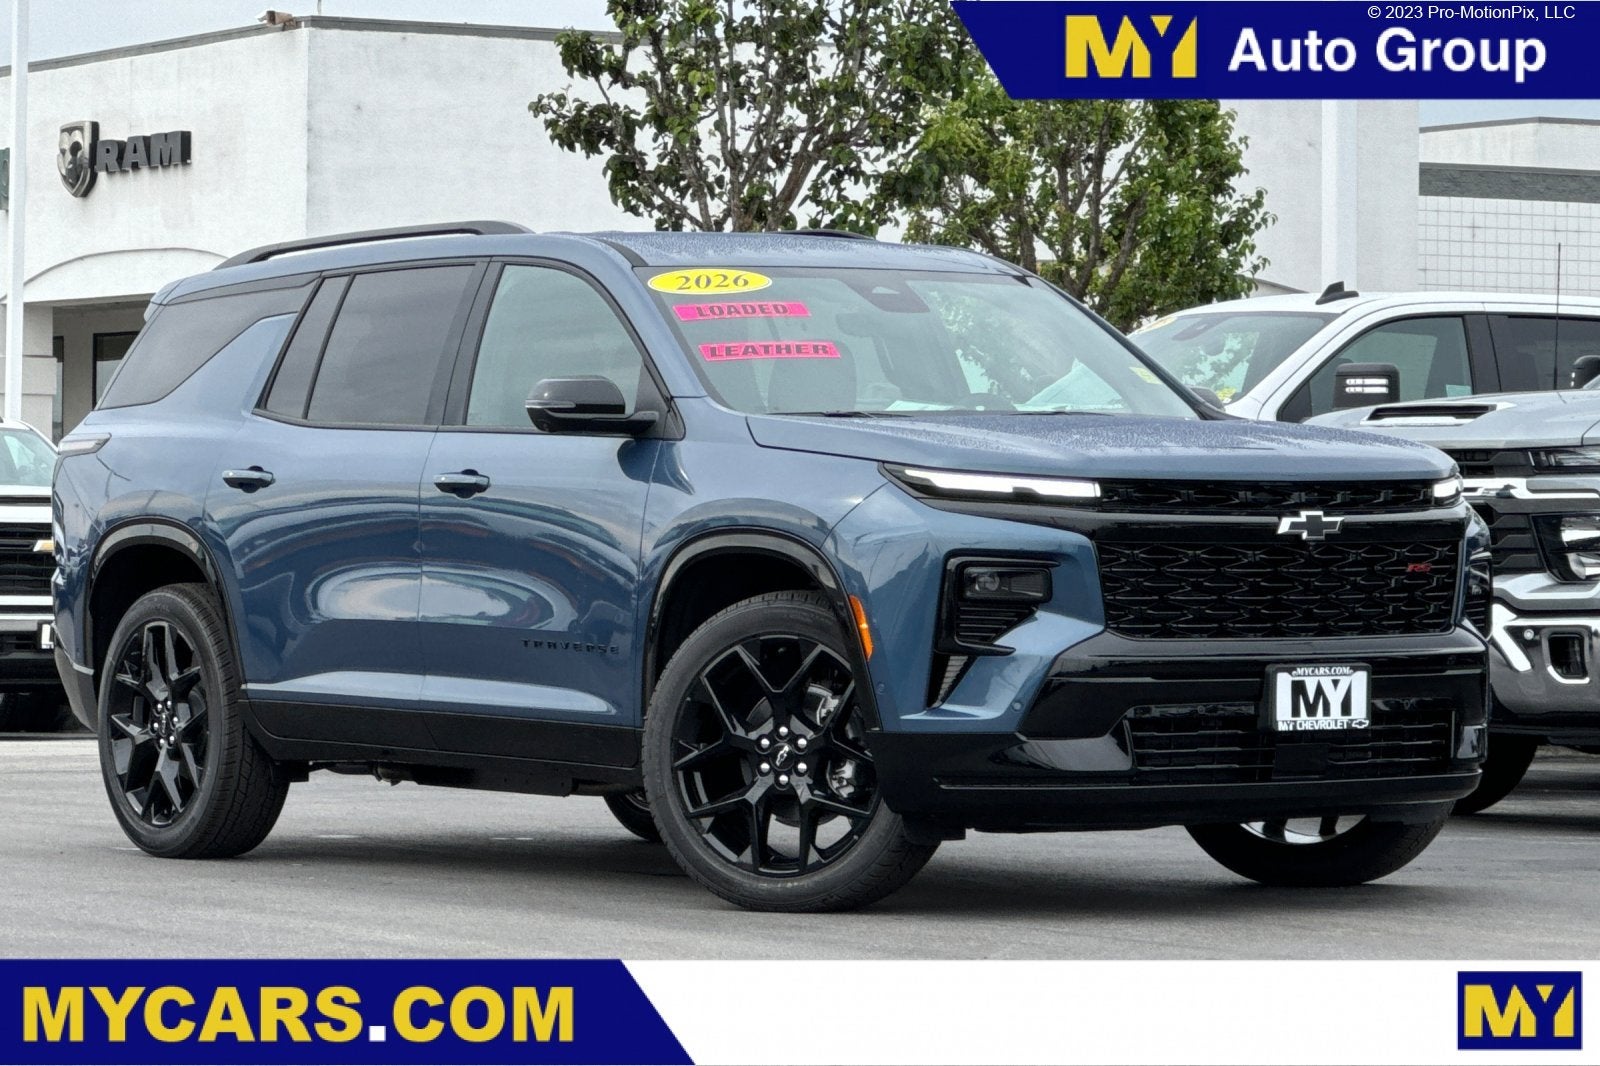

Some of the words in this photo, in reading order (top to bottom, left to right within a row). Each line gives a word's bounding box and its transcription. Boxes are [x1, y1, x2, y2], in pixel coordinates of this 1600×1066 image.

[96, 130, 190, 173] RAM
[675, 273, 749, 291] 2026
[696, 303, 789, 317] LOADED
[709, 343, 830, 358] LEATHER
[521, 639, 620, 654] TRAVERSE
[1296, 666, 1351, 676] MYCARS.COM
[1291, 679, 1352, 718] MY
[1278, 720, 1295, 732] MY
[1296, 719, 1348, 730] CHEVROLET
